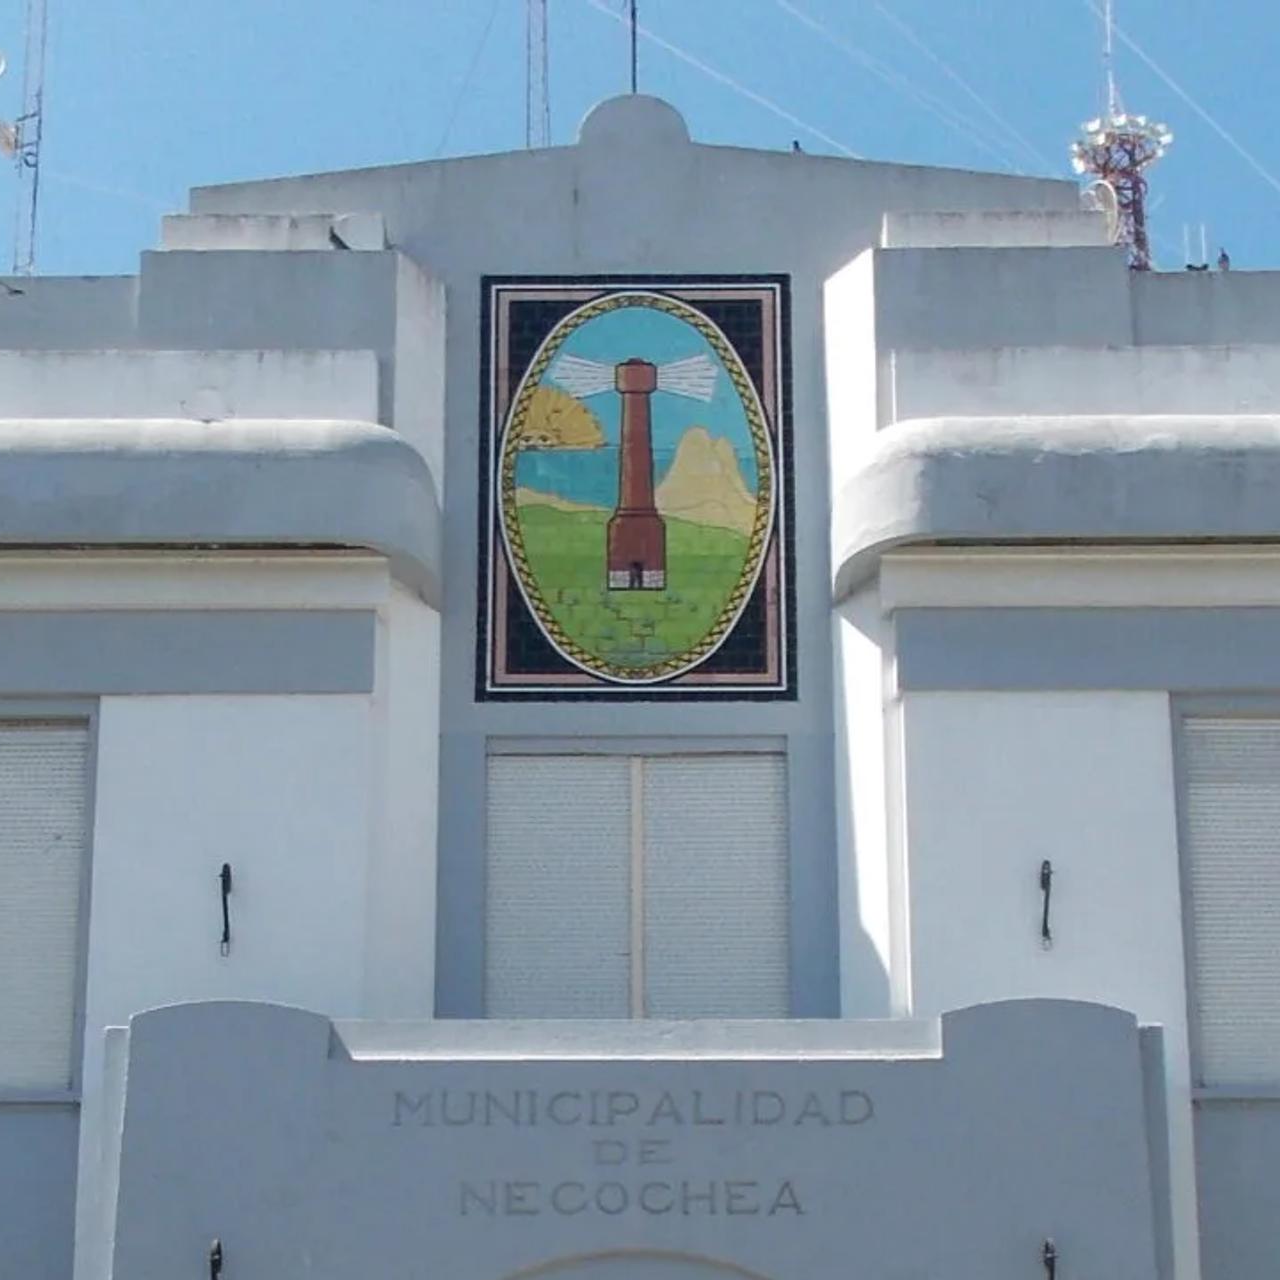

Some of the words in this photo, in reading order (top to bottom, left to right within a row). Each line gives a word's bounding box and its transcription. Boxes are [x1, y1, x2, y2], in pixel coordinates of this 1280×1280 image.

[392, 1090, 875, 1127] MUNICIPALIDAD
[593, 1139, 673, 1165] DE
[458, 1181, 807, 1216] NECOCHEA
